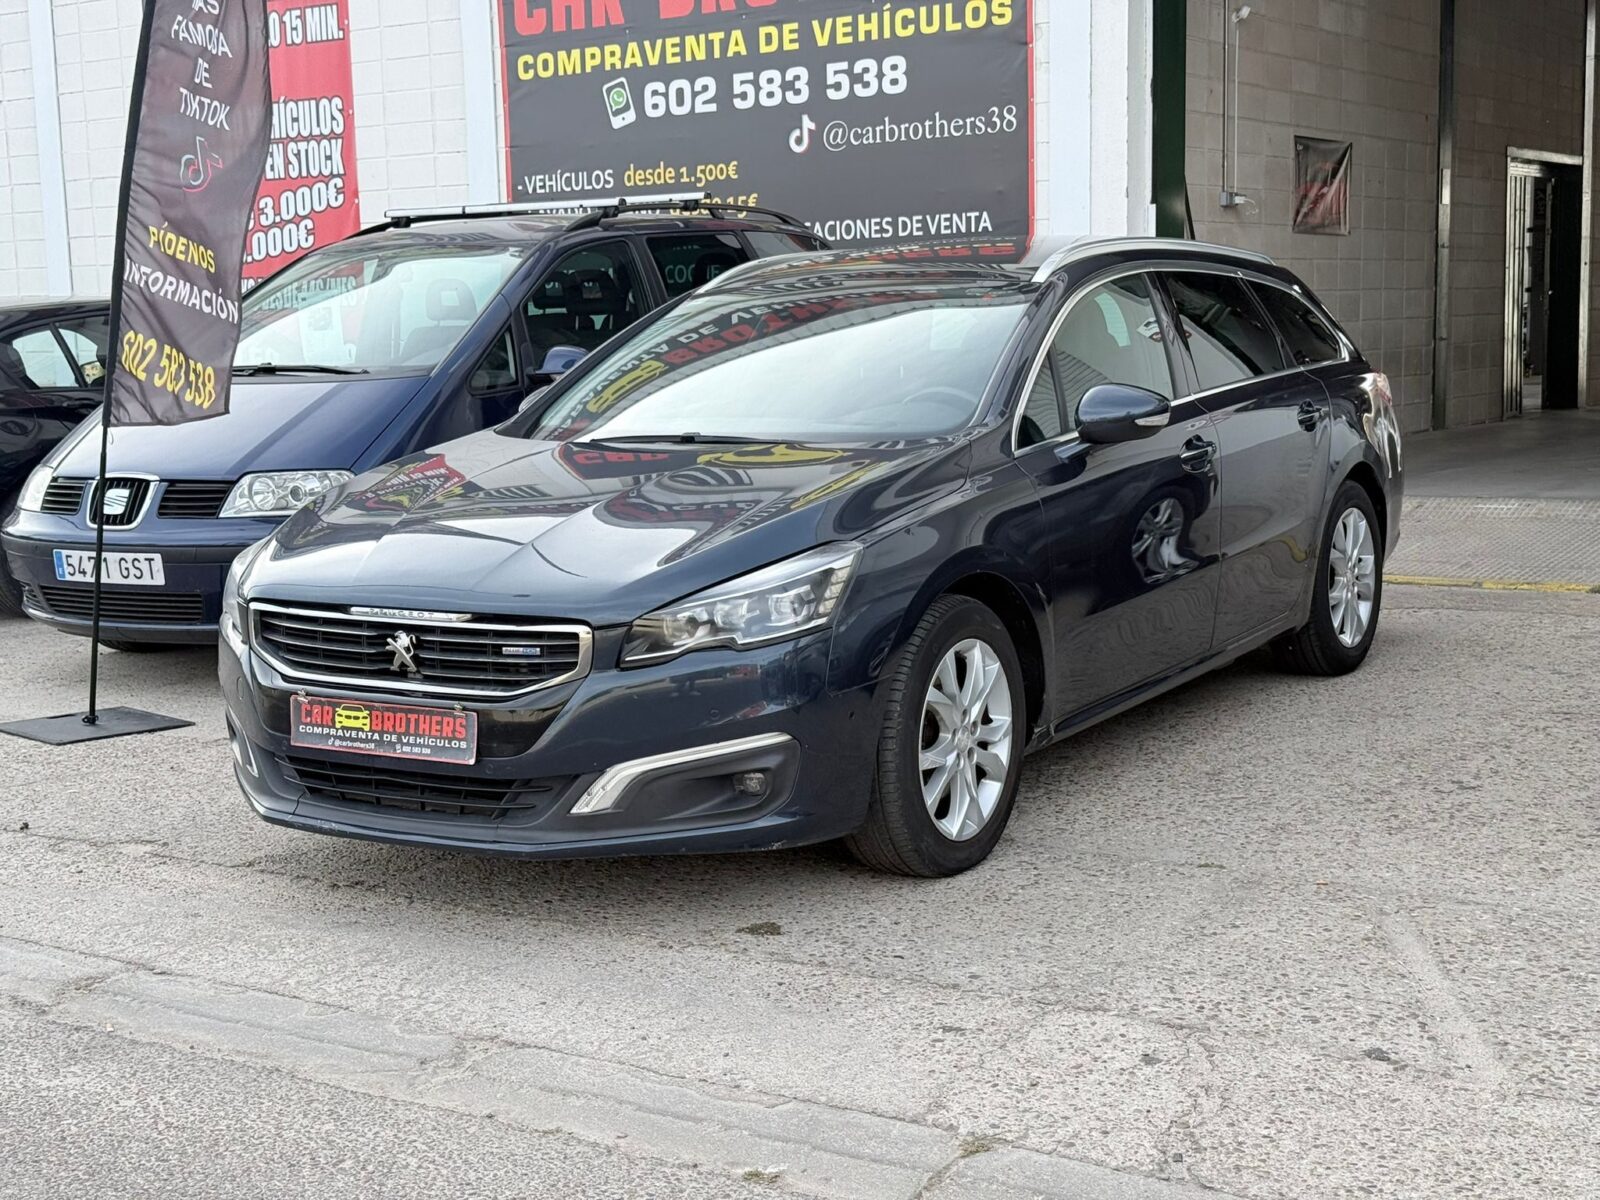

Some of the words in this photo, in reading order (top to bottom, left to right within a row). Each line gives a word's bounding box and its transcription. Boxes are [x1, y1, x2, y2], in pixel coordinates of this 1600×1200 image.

[171, 15, 232, 57] FAMOSA
[282, 9, 302, 45] 15
[305, 5, 343, 42] MIN.
[517, 29, 747, 80] COMPRAVENTA
[759, 22, 799, 53] DE
[812, 0, 1012, 47] VEHÍCULOS
[194, 57, 212, 88] DE
[643, 76, 717, 118] 602
[732, 66, 809, 109] 583
[826, 55, 908, 100] 538
[179, 87, 231, 130] TIKTOK
[271, 96, 344, 139] HÍCULOS
[823, 104, 1017, 151] @carbrothers38
[265, 143, 285, 179] EN
[287, 139, 344, 178] STOCK
[624, 161, 675, 187] desde
[680, 161, 738, 187] 1.500€
[259, 178, 344, 226] 3.000€
[149, 222, 215, 273] PÍDENOS
[243, 219, 314, 263] .000€
[804, 216, 893, 241] ACIONES
[898, 215, 923, 237] DE
[925, 211, 993, 234] VENTA
[124, 259, 238, 324] INFORMACIÓN
[122, 330, 157, 382] 602
[154, 345, 185, 394] 583
[185, 359, 215, 409] 538
[65, 555, 110, 579] 5471
[119, 557, 155, 580] GST
[299, 725, 380, 741] COMPRAVENTA
[383, 733, 398, 742] DE
[401, 735, 467, 749] VEHÍCULOS
[301, 703, 333, 726] CAR
[371, 710, 466, 738] BROTHERS
